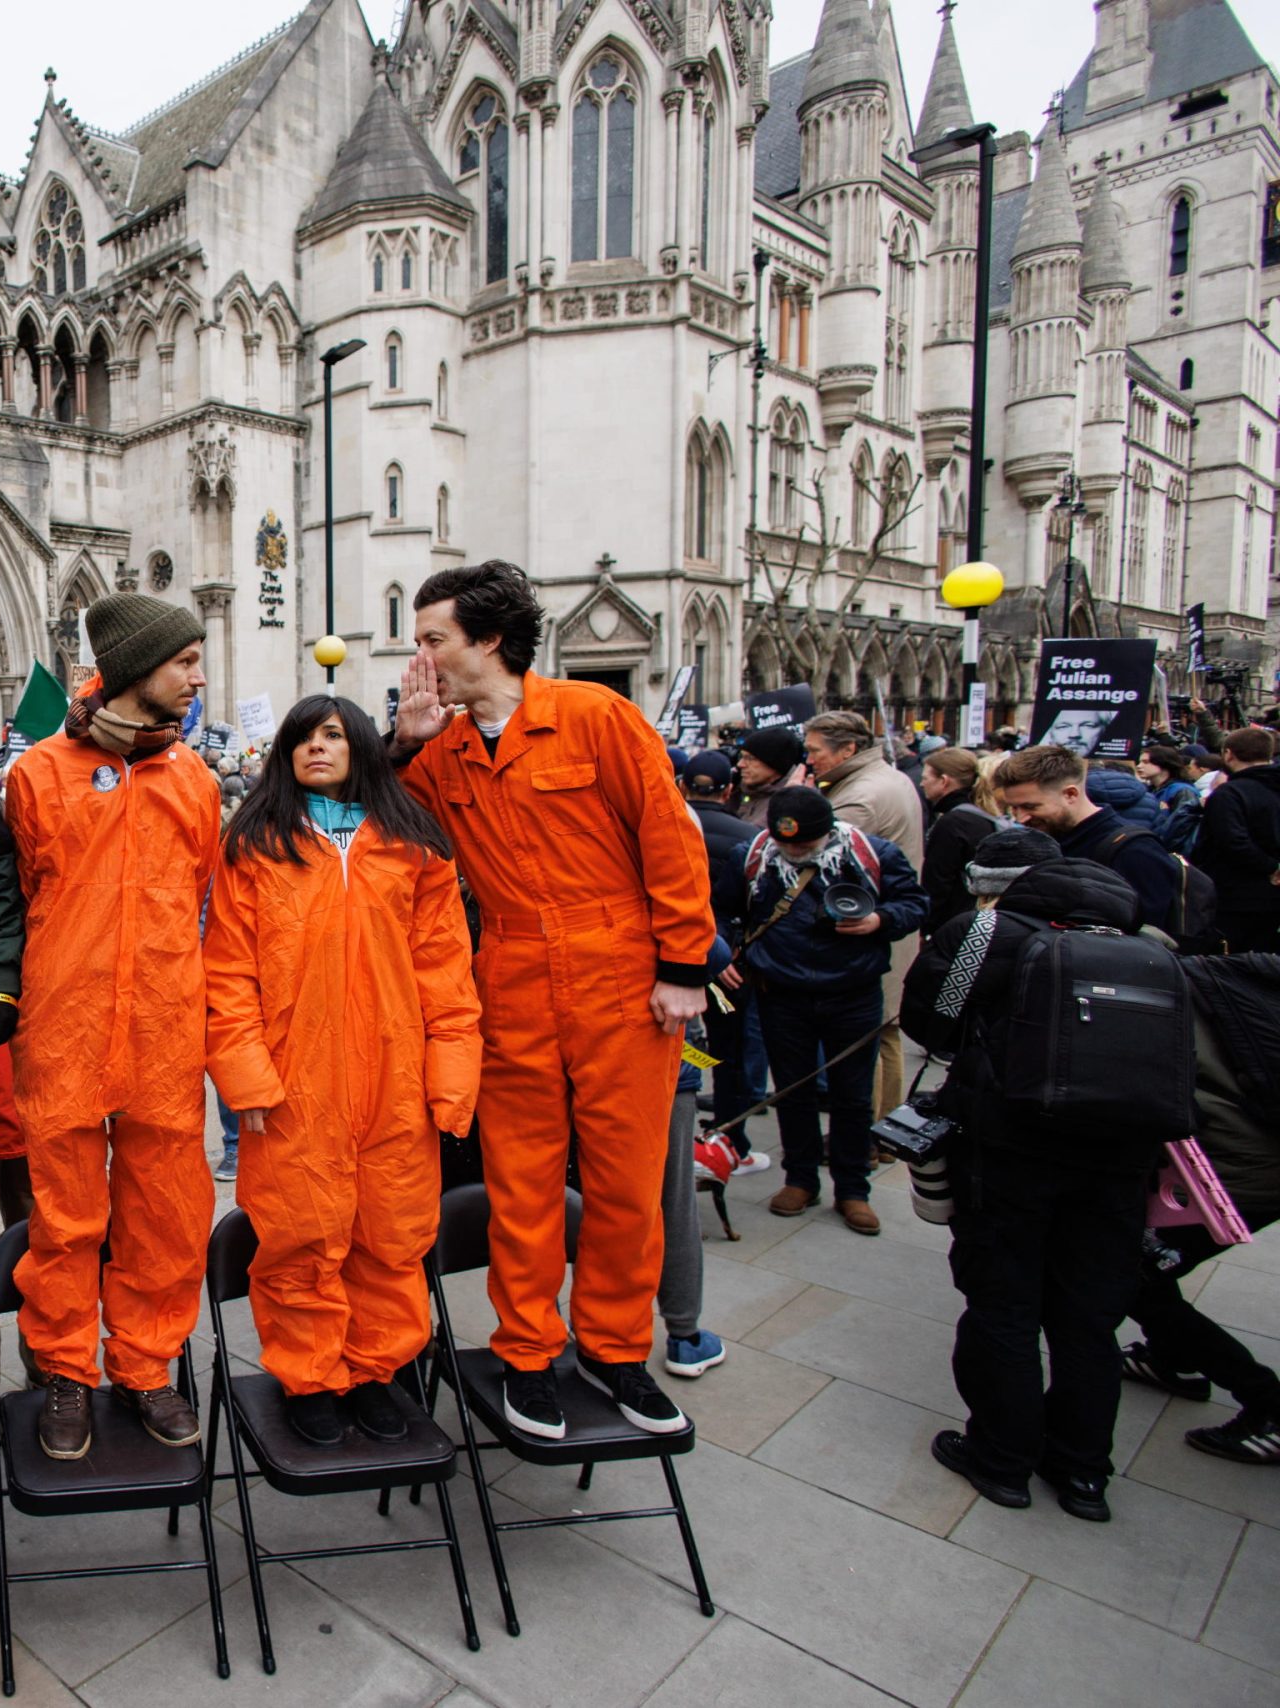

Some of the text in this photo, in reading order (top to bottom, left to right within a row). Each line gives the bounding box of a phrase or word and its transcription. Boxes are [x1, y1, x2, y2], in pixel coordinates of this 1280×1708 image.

[262, 570, 278, 582] The
[260, 582, 282, 594] Royal
[258, 594, 284, 606] Courts
[267, 606, 276, 616] of
[258, 616, 285, 630] Justice
[1051, 656, 1096, 670] Free
[1048, 671, 1111, 685] Julian
[1046, 687, 1138, 704] Assange
[753, 704, 780, 717] Free
[756, 713, 792, 729] Julian
